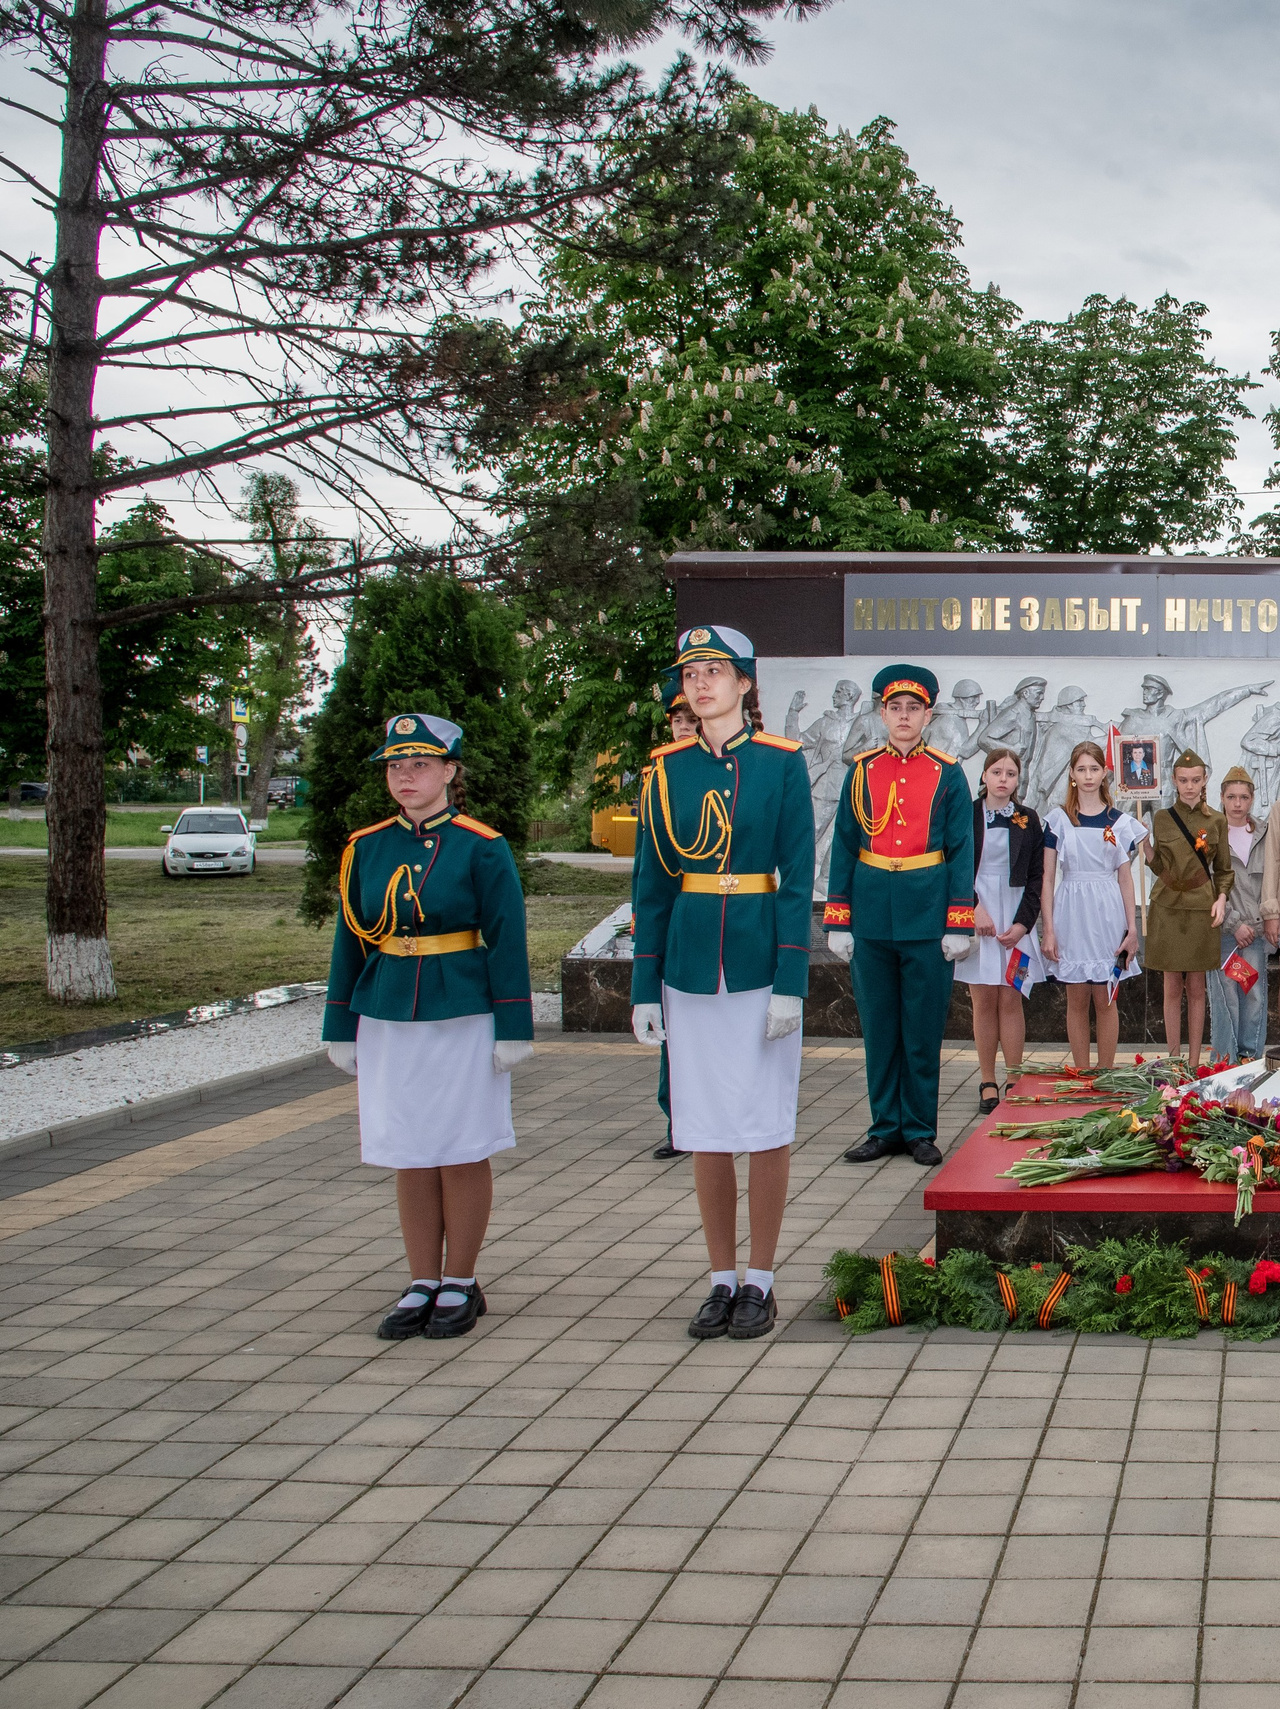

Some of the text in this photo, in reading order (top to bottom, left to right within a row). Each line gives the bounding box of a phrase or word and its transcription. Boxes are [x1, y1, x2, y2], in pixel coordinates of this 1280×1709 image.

[853, 597, 962, 631] НИКТО
[971, 597, 1011, 631] НЕ
[1019, 597, 1149, 635] ЗАБЫТ,
[1165, 598, 1278, 632] НИЧТО
